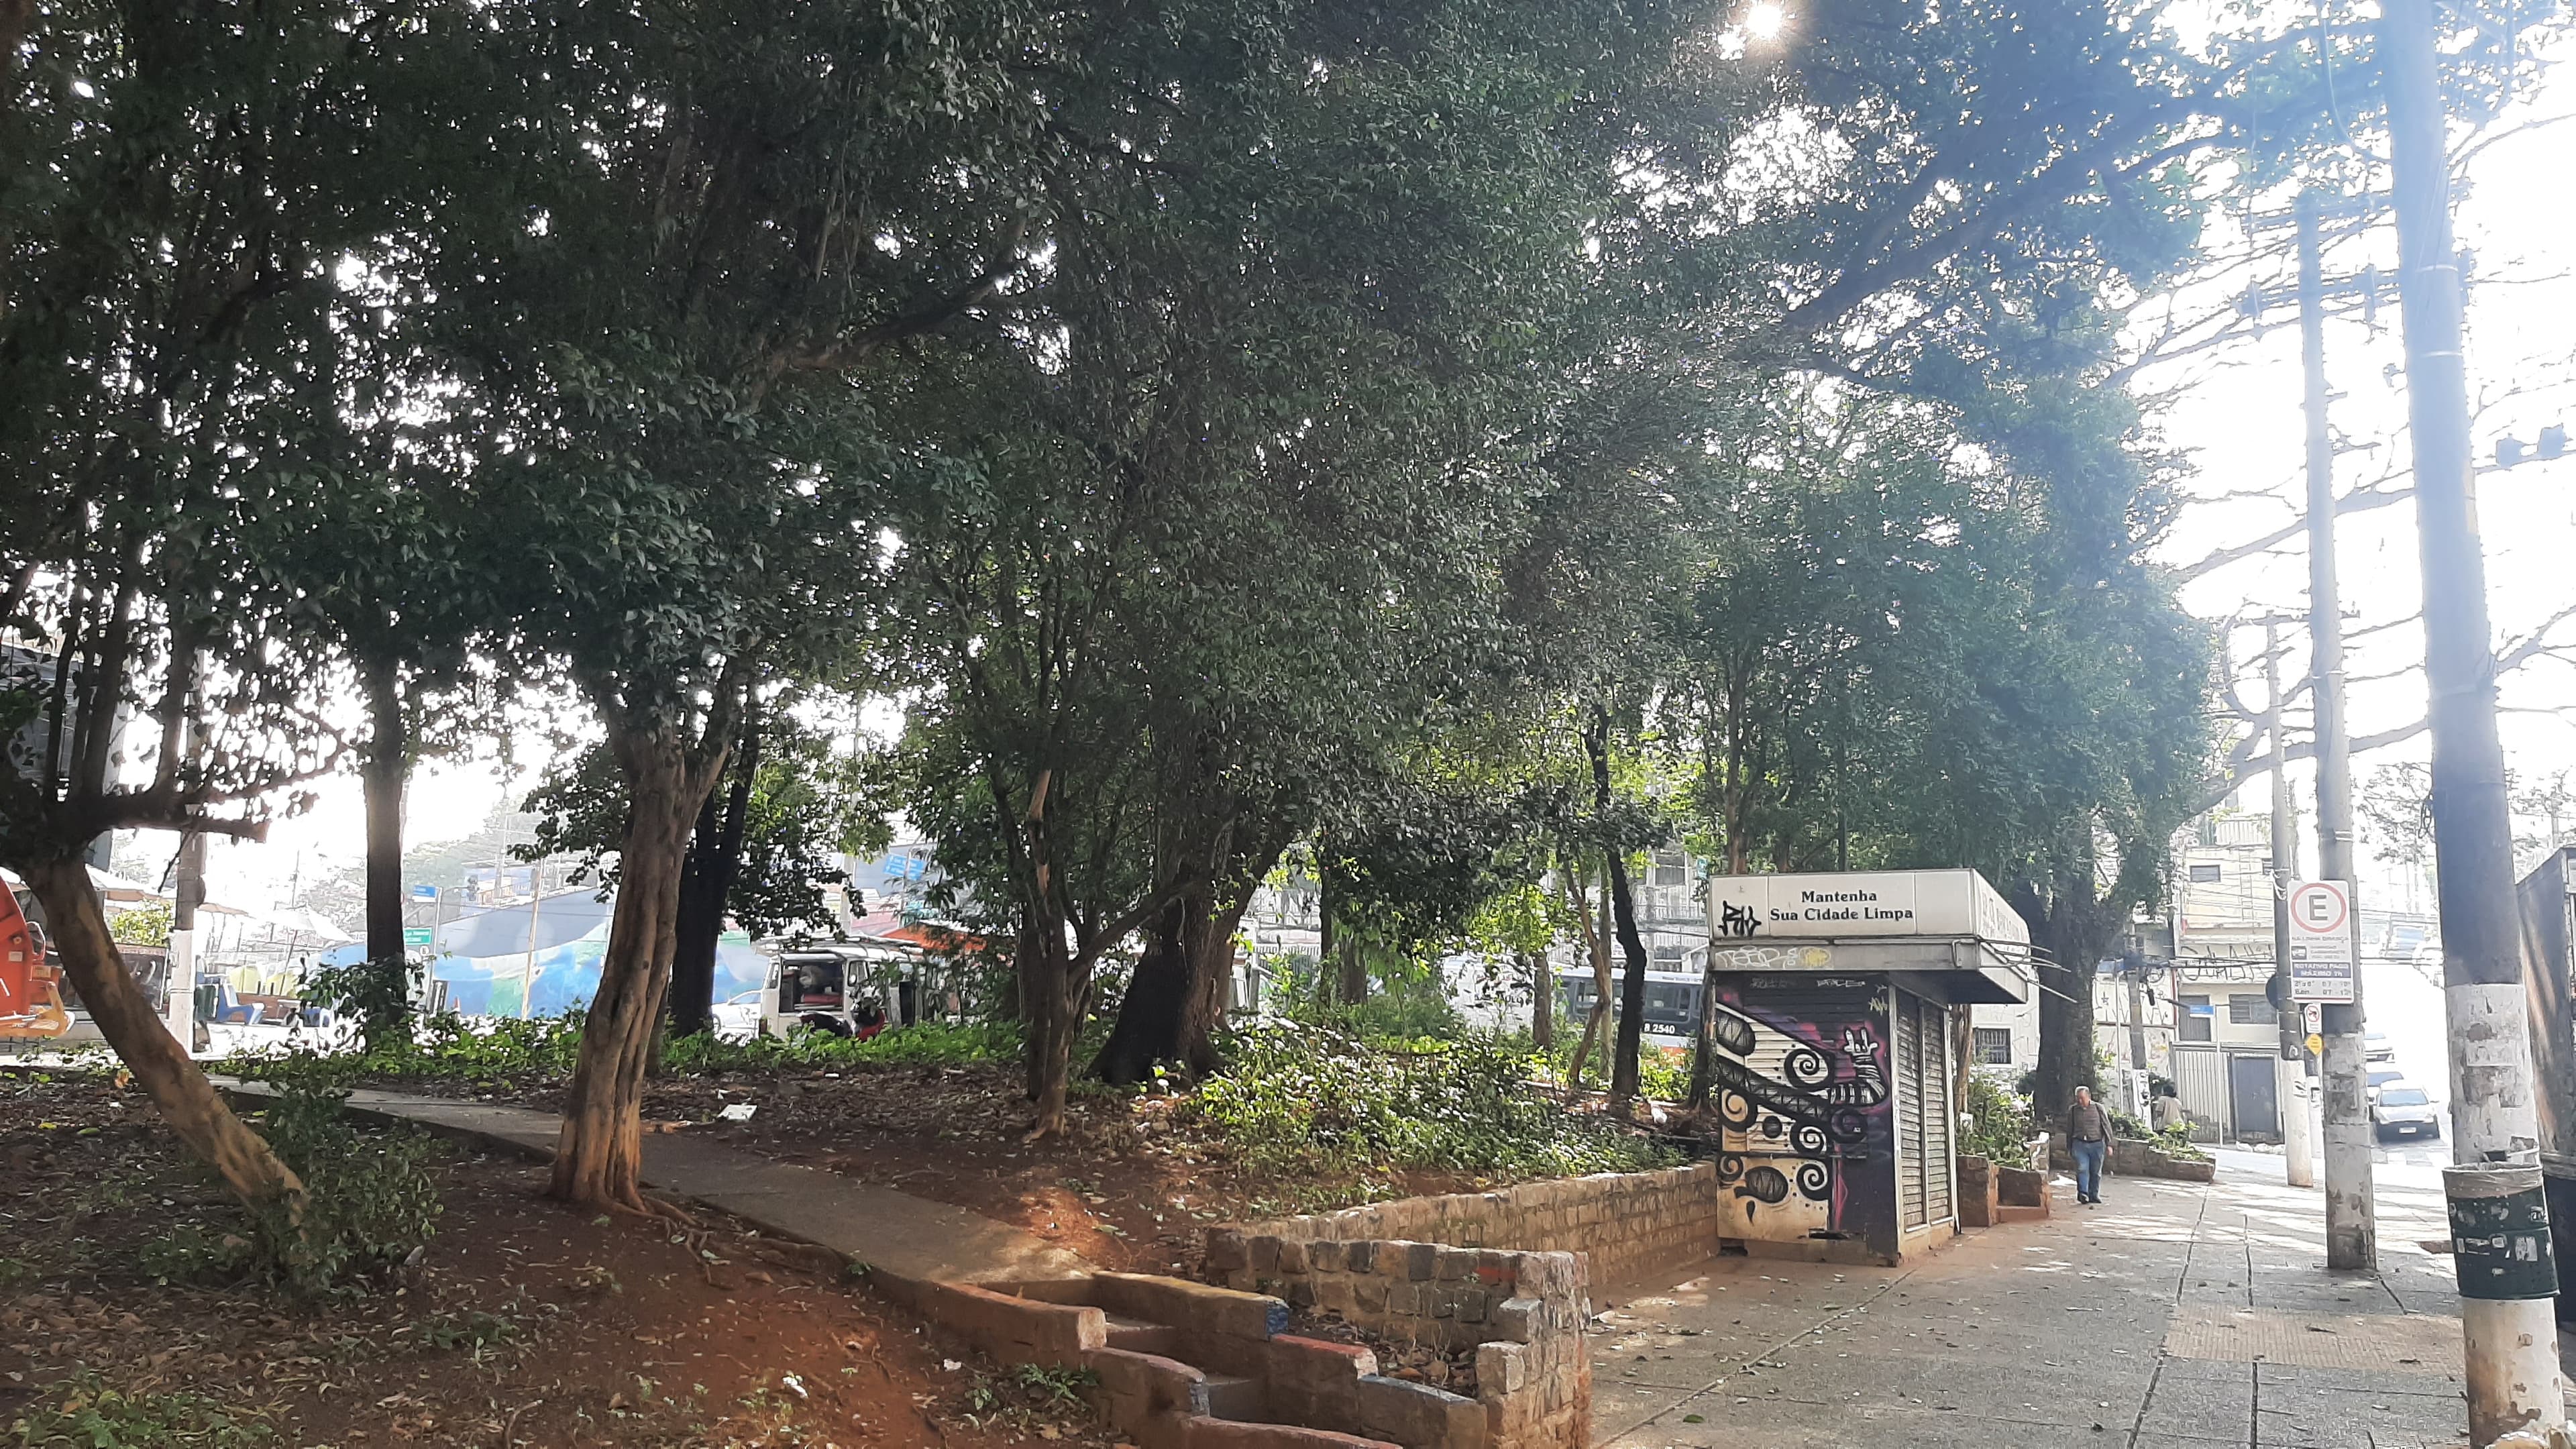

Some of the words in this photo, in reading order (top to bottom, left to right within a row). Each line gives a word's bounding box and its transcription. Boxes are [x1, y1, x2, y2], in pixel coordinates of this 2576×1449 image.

[1801, 890, 1877, 903] Mantenha
[1770, 908, 1799, 921] Sua
[1804, 907, 1859, 920] Cidade
[1864, 908, 1913, 921] Limpa
[2308, 894, 2328, 921] E
[1652, 1023, 1676, 1034] 2540
